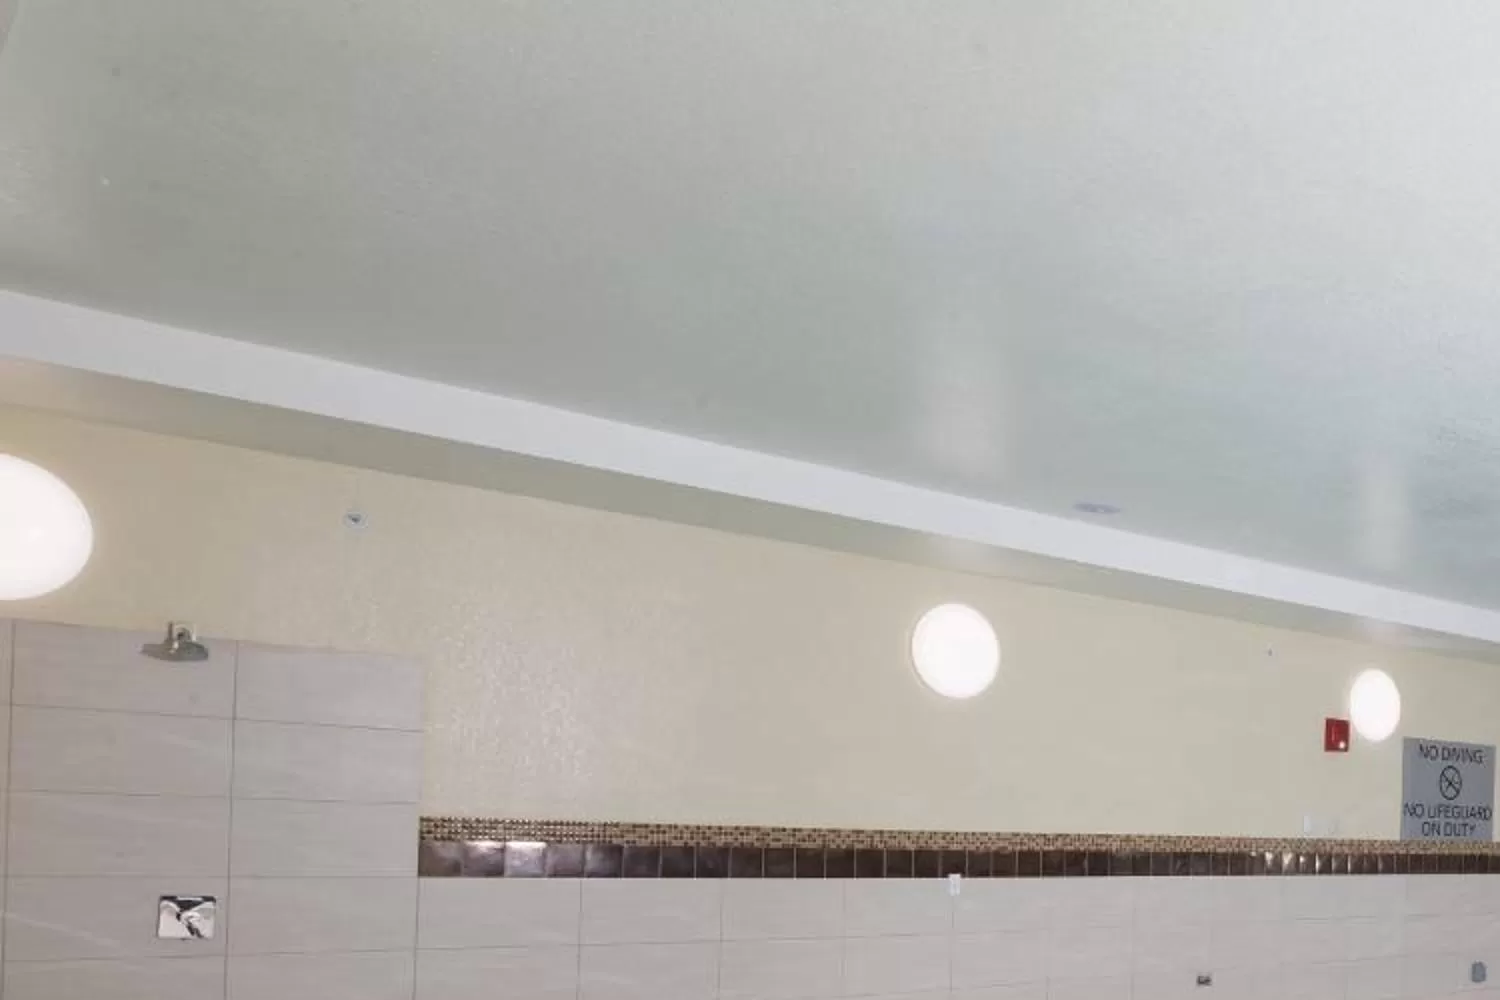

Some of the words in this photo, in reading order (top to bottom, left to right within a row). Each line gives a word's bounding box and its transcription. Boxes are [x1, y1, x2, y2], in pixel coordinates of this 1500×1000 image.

[1419, 743, 1439, 761] NO
[1441, 745, 1486, 765] DIVING
[1403, 802, 1425, 818] NO
[1427, 803, 1492, 821] LIFEGUARD
[1421, 821, 1441, 837] ON
[1443, 822, 1477, 837] DUTY
